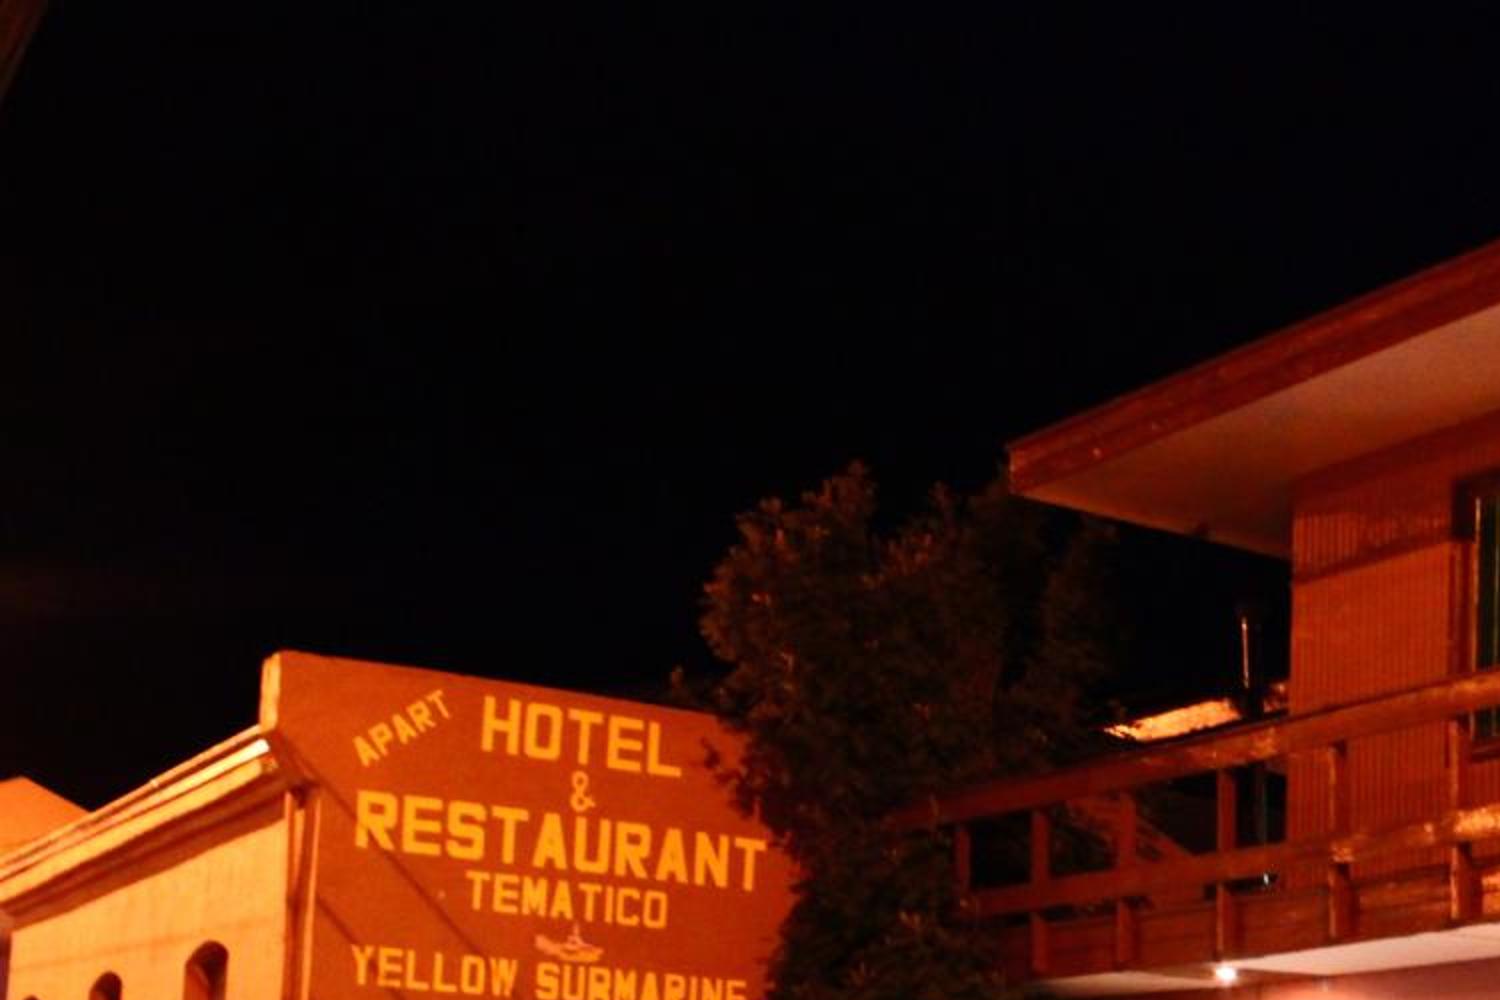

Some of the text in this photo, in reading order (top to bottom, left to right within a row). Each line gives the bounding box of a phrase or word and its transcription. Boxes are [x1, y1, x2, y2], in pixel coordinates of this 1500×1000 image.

[353, 689, 451, 768] APART
[480, 695, 682, 778] HOTEL
[569, 771, 596, 812] &
[354, 789, 767, 891] RESTAURANT
[465, 870, 668, 929] TEMATICO
[351, 944, 518, 997] YELLOW
